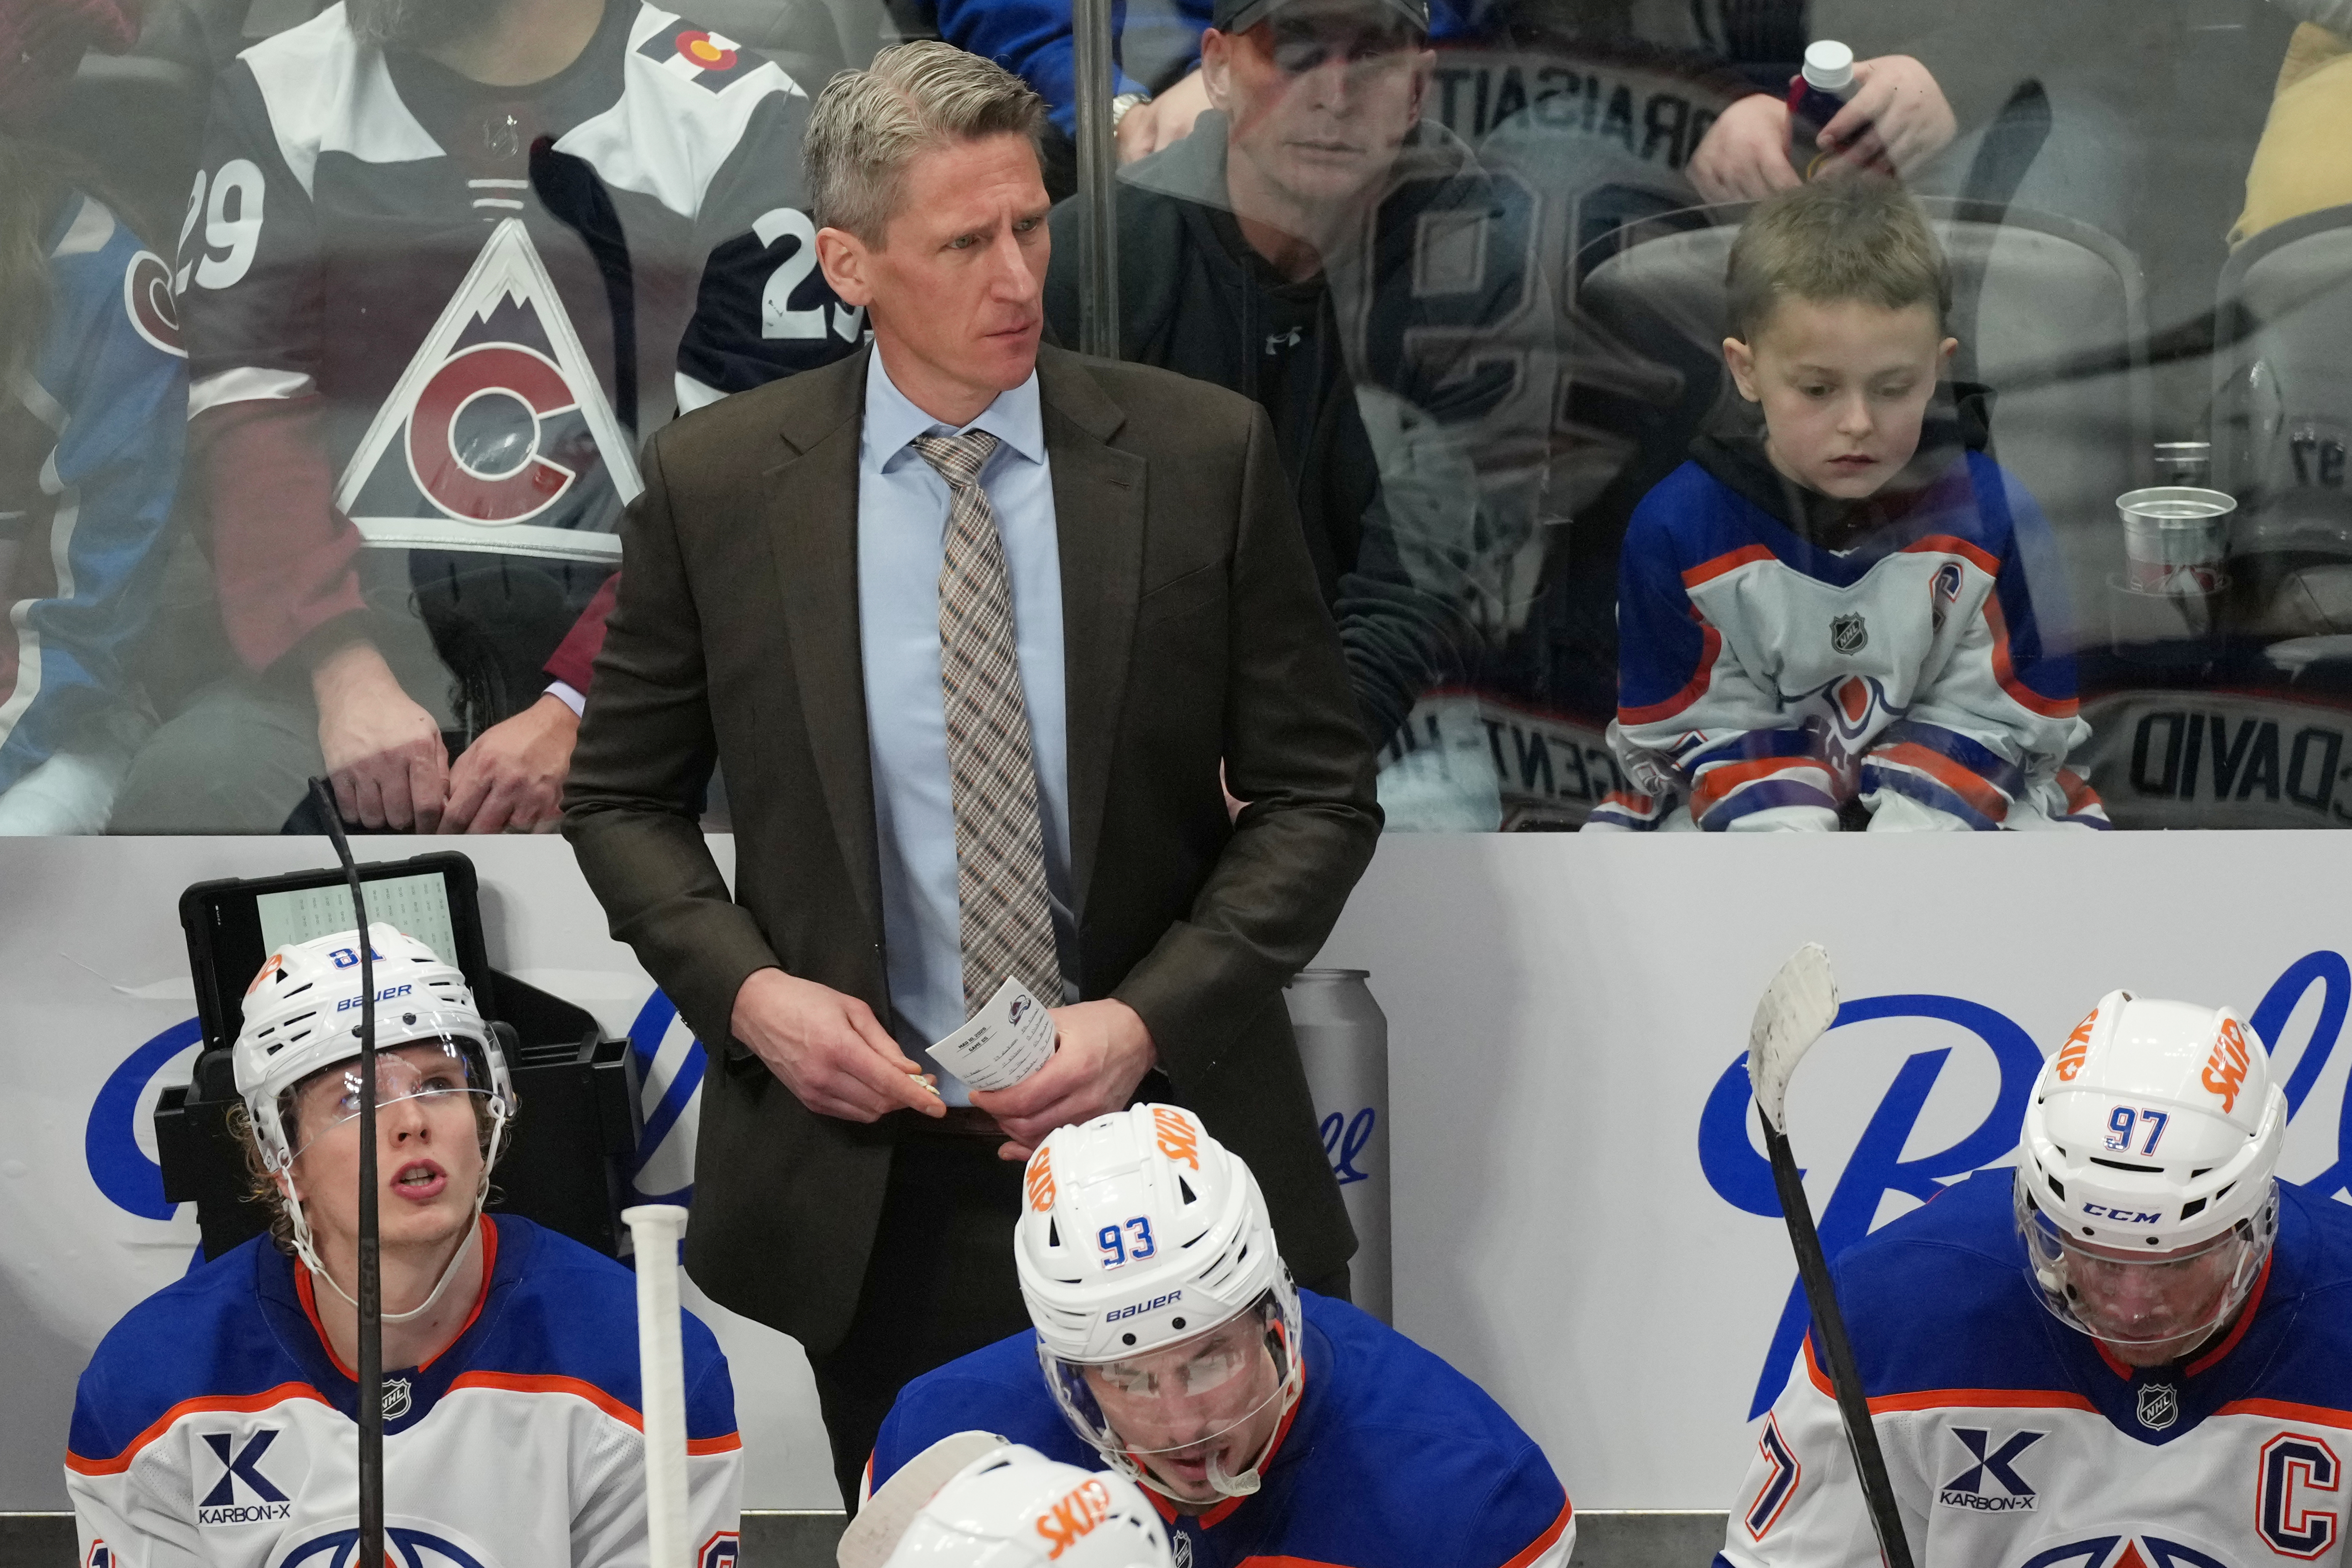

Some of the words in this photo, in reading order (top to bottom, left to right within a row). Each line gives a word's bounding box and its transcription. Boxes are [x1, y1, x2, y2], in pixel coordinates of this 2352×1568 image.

[175, 158, 265, 296] 29
[752, 207, 865, 345] 2
[968, 1042, 981, 1052] GAME
[2056, 1008, 2098, 1082] SKIP
[2201, 1018, 2251, 1115] SKIP
[1153, 1107, 1199, 1171] SKIP
[2103, 1105, 2170, 1157] 97
[1026, 1146, 1056, 1212] SKIP
[1096, 1214, 1157, 1270] 93
[2082, 1202, 2163, 1224] CCM
[1106, 1289, 1182, 1323] BAUER
[1745, 1410, 1801, 1542] 7
[1940, 1491, 2036, 1511] KARBON-X
[2256, 1432, 2341, 1561] C
[199, 1503, 291, 1525] KARBON-X
[1036, 1479, 1110, 1561] SKIP
